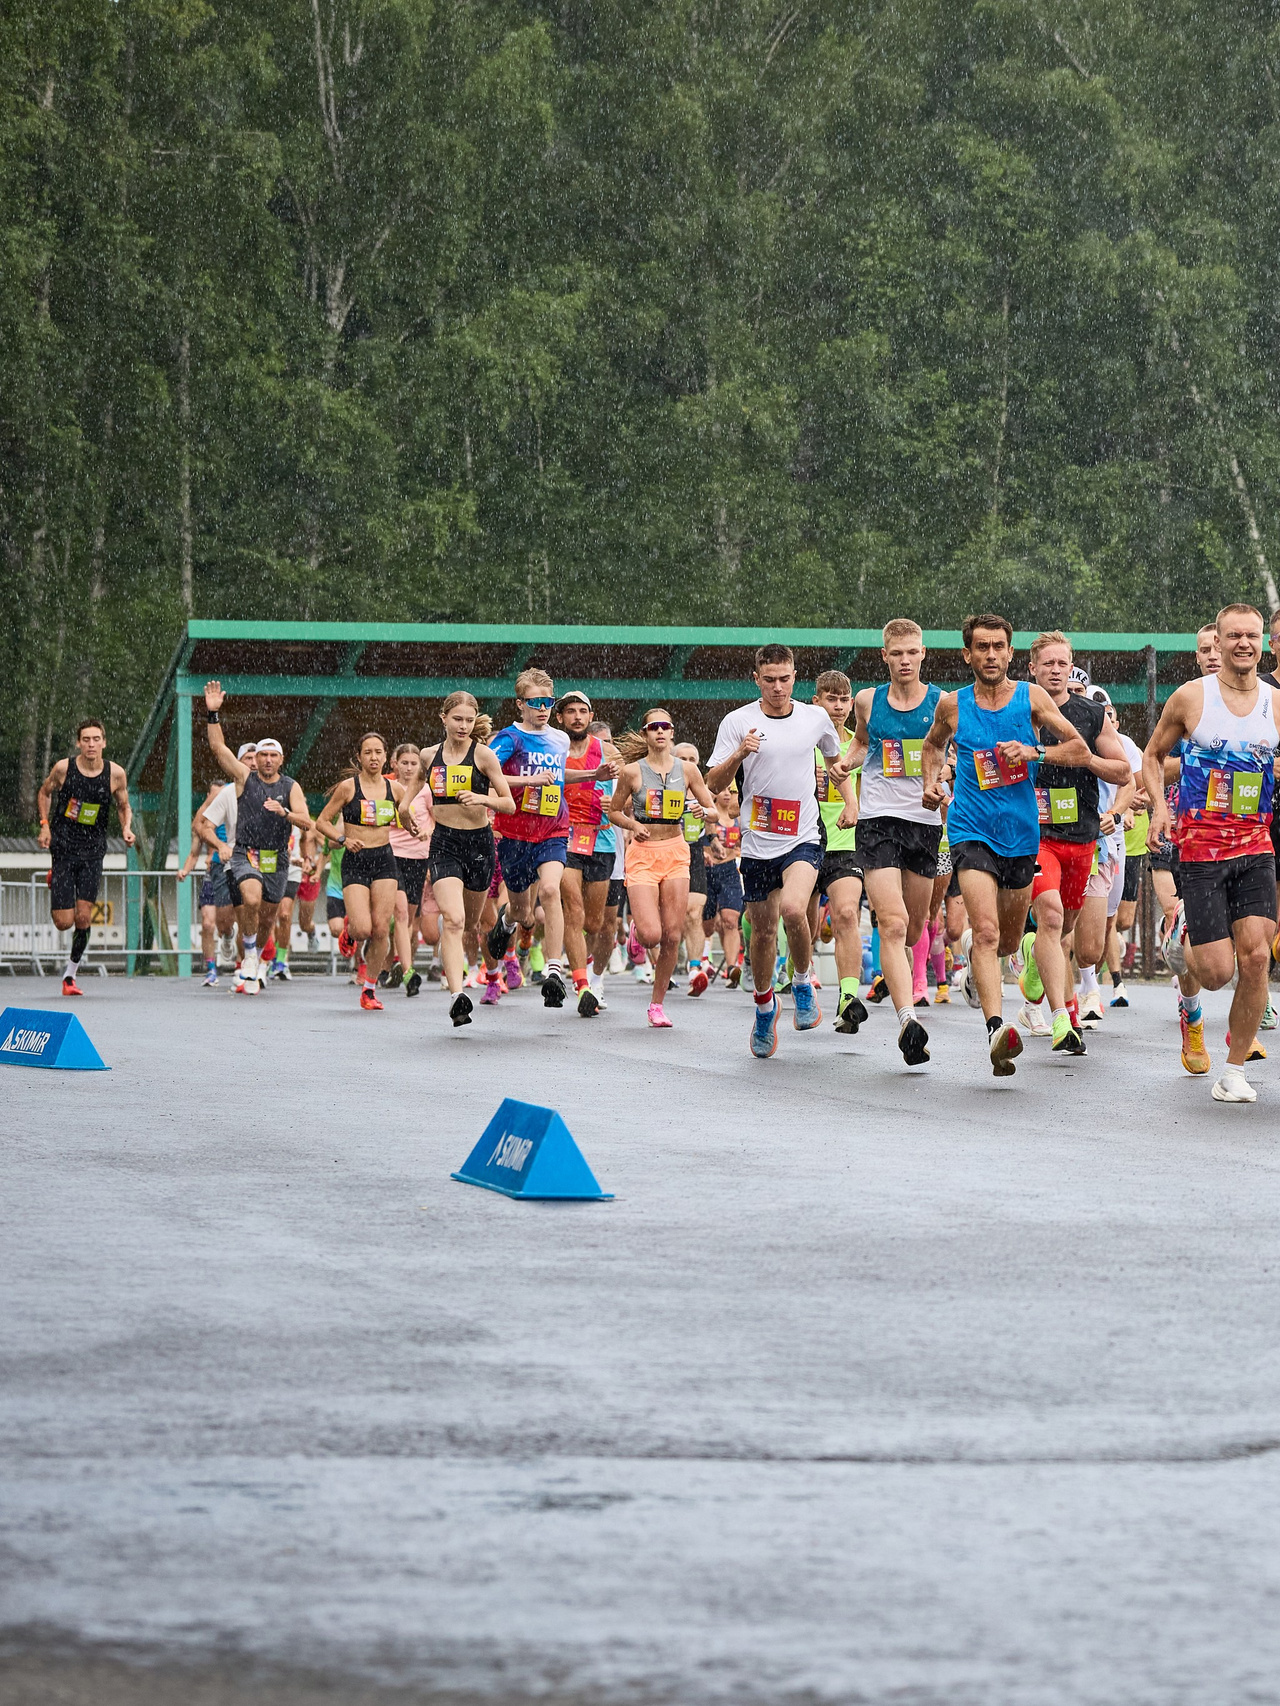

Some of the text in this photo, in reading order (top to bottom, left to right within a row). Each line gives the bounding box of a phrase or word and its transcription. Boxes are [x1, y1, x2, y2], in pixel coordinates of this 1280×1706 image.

[1069, 670, 1088, 683] IKE
[452, 775, 467, 783] 110
[1239, 785, 1258, 797] 166
[545, 794, 559, 803] 105
[1056, 799, 1075, 810] 163
[777, 809, 796, 822] 116
[579, 836, 590, 845] 21
